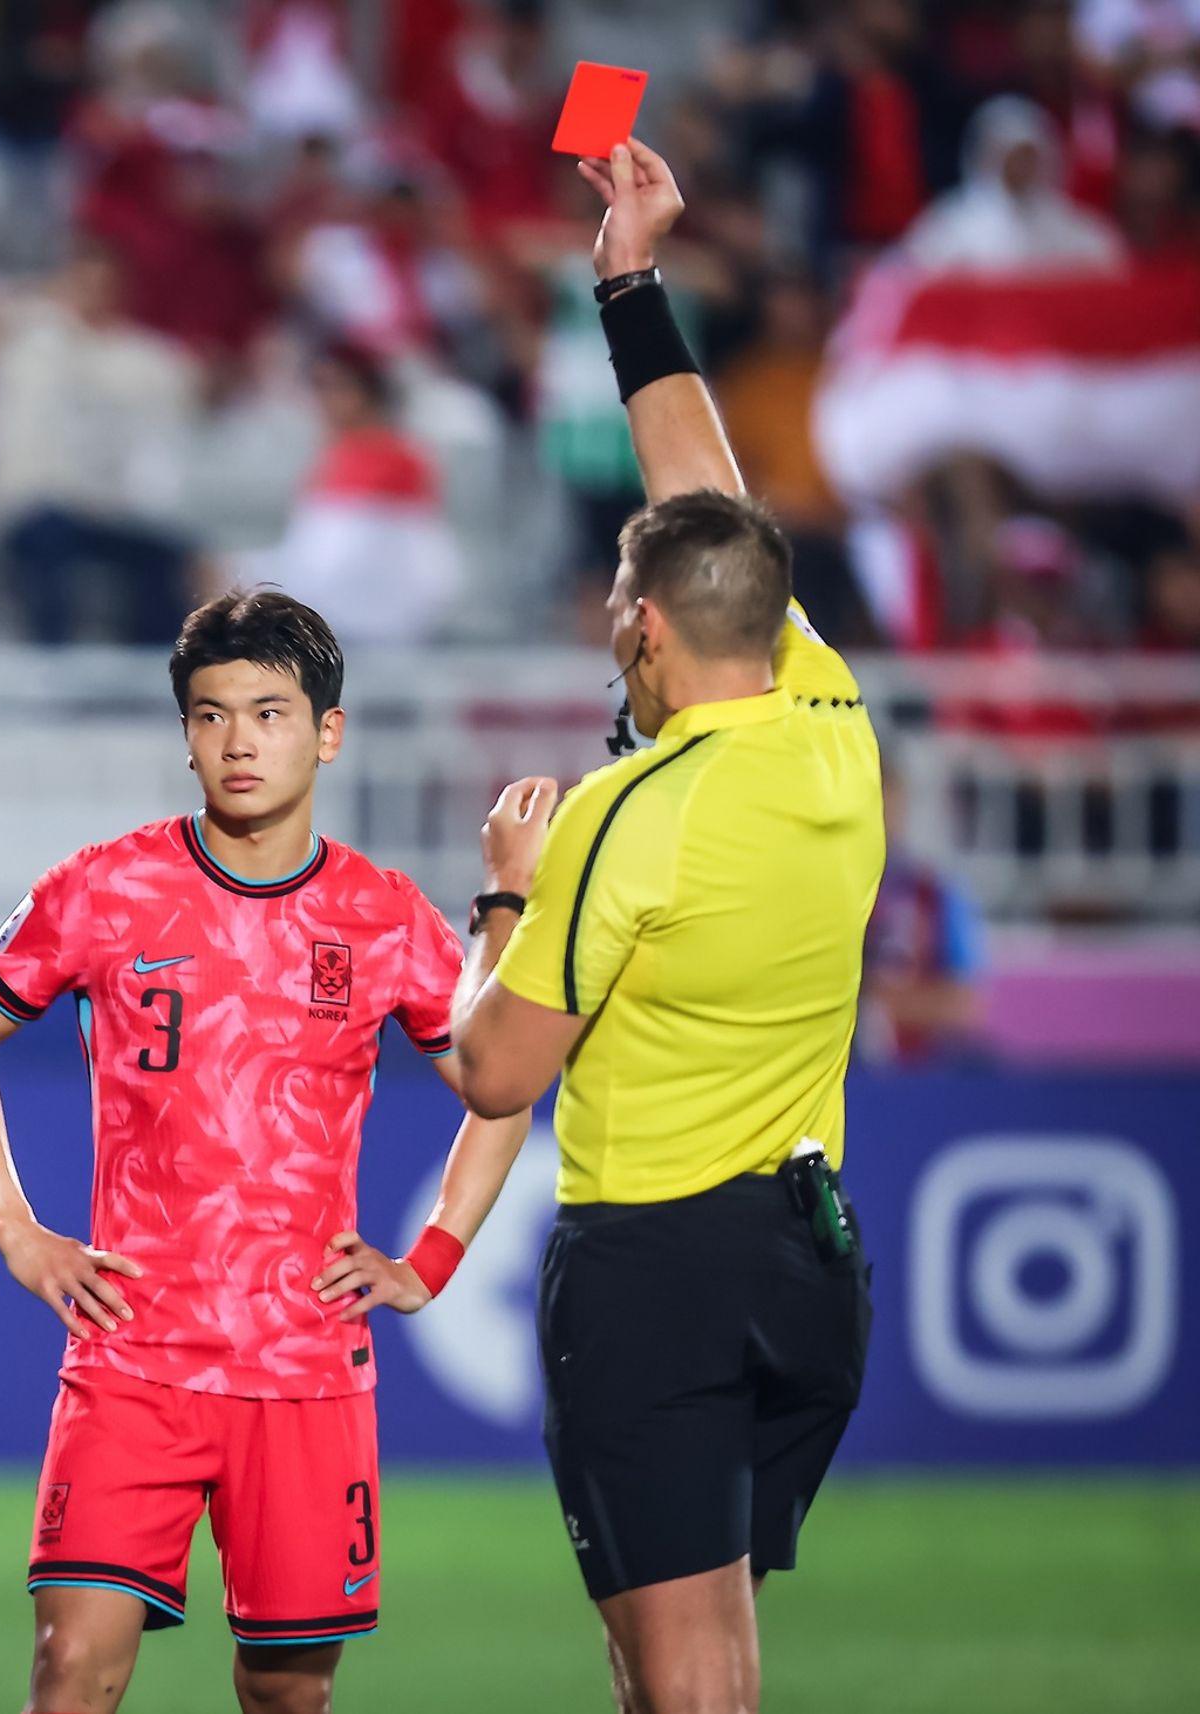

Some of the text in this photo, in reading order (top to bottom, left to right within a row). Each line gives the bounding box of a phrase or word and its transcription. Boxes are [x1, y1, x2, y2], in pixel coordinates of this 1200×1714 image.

[138, 989, 182, 1072] 3
[308, 1007, 349, 1022] KOREA
[346, 1480, 375, 1566] 3
